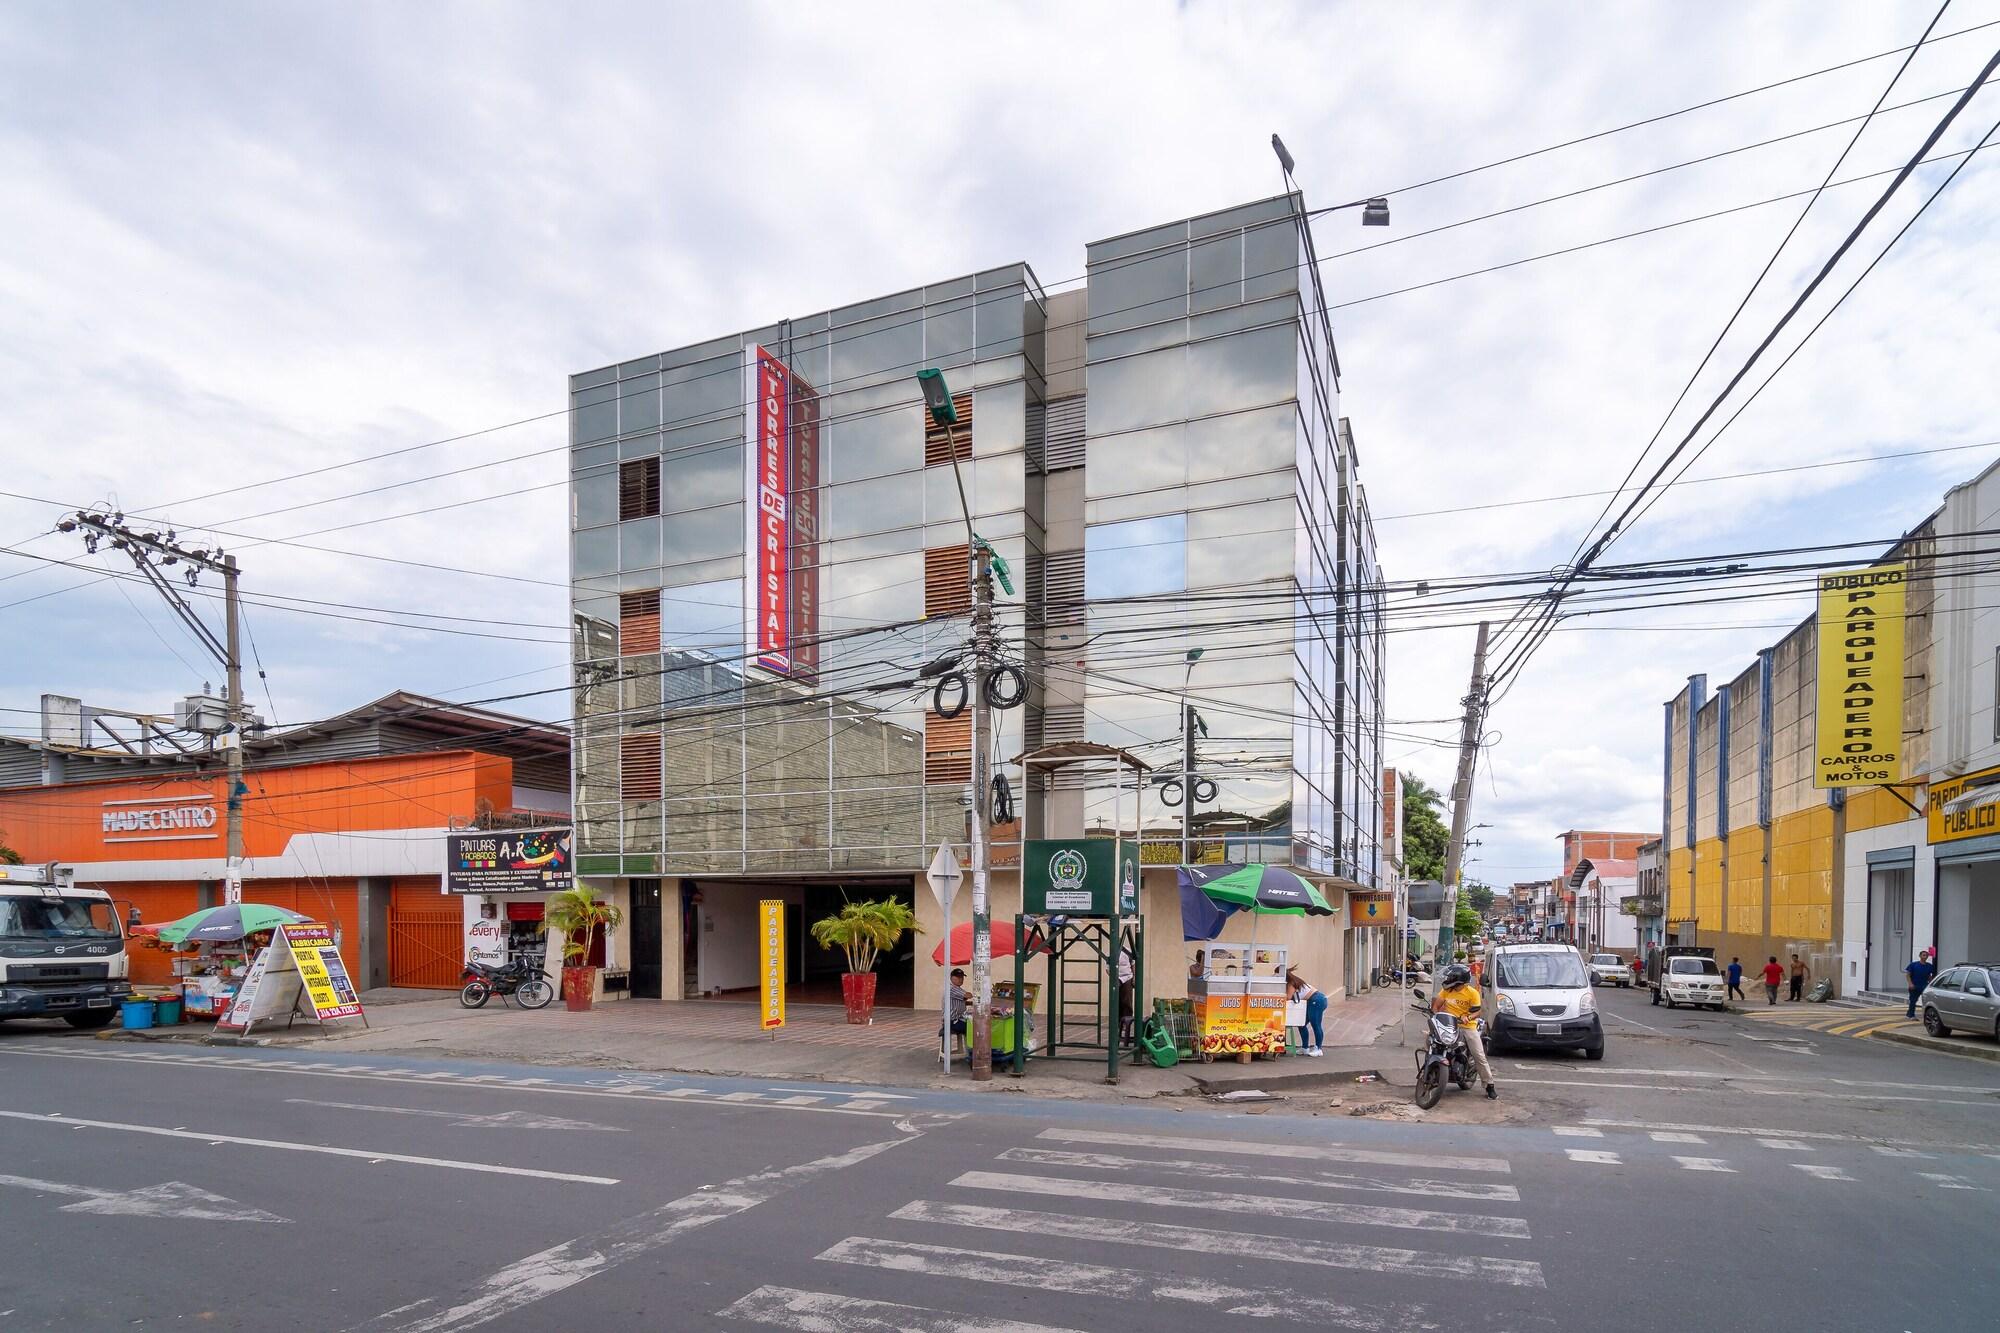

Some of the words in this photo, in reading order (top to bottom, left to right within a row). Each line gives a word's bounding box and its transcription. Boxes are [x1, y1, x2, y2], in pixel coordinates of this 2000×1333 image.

[766, 374, 779, 490] TORRES
[763, 491, 783, 514] DE
[767, 515, 779, 649] CRISTAL
[1823, 571, 1902, 591] PUBLICO
[1843, 590, 1876, 753] PARQUEADERO
[1820, 753, 1896, 766] CARROS
[1851, 764, 1862, 772] &
[1826, 770, 1889, 782] MOTOS
[102, 806, 217, 832] MADECENTRO
[1944, 804, 1996, 834] PUBLICO
[460, 839, 496, 851] PINTURAS
[465, 851, 497, 860] ACABADOS
[472, 927, 500, 941] every
[291, 938, 333, 947] FABRICAMOS
[294, 950, 315, 961] PUERTAS
[768, 907, 779, 1017] PARQUEADERO
[301, 964, 321, 975] COCINAS
[306, 976, 331, 988] INTEGRALES
[1219, 998, 1241, 1008] JUGOS
[1249, 998, 1284, 1008] NATURALES
